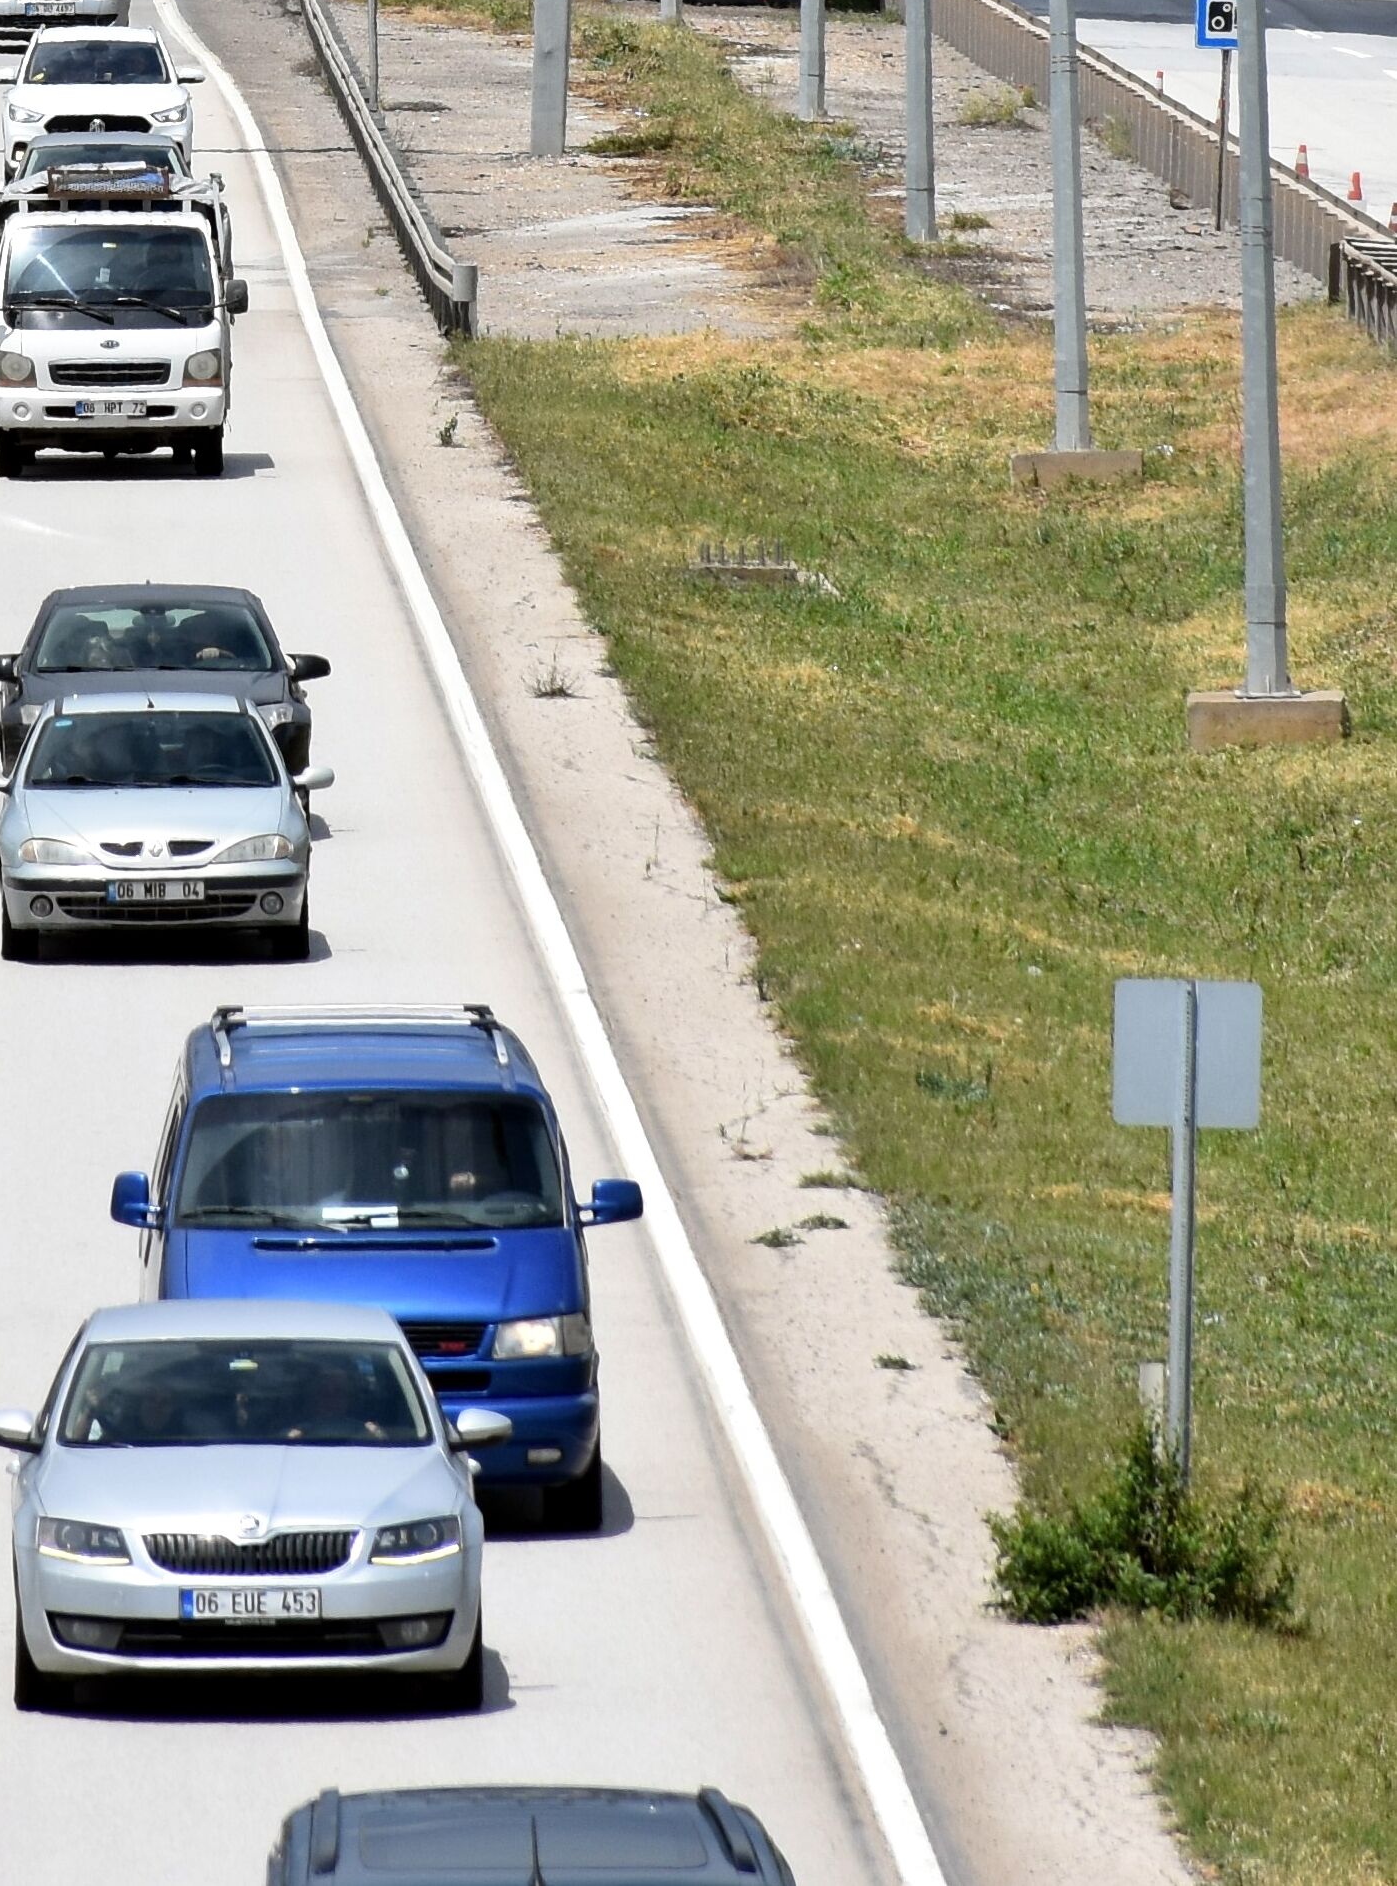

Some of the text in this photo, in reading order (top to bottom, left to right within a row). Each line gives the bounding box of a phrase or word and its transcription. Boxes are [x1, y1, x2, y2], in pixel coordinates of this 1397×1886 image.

[104, 402, 123, 413] HPT
[132, 402, 146, 414] 72
[117, 882, 134, 899] 06
[183, 882, 200, 898] 04
[195, 1592, 219, 1613] 06
[232, 1592, 267, 1614] EUE
[281, 1592, 316, 1613] 453
